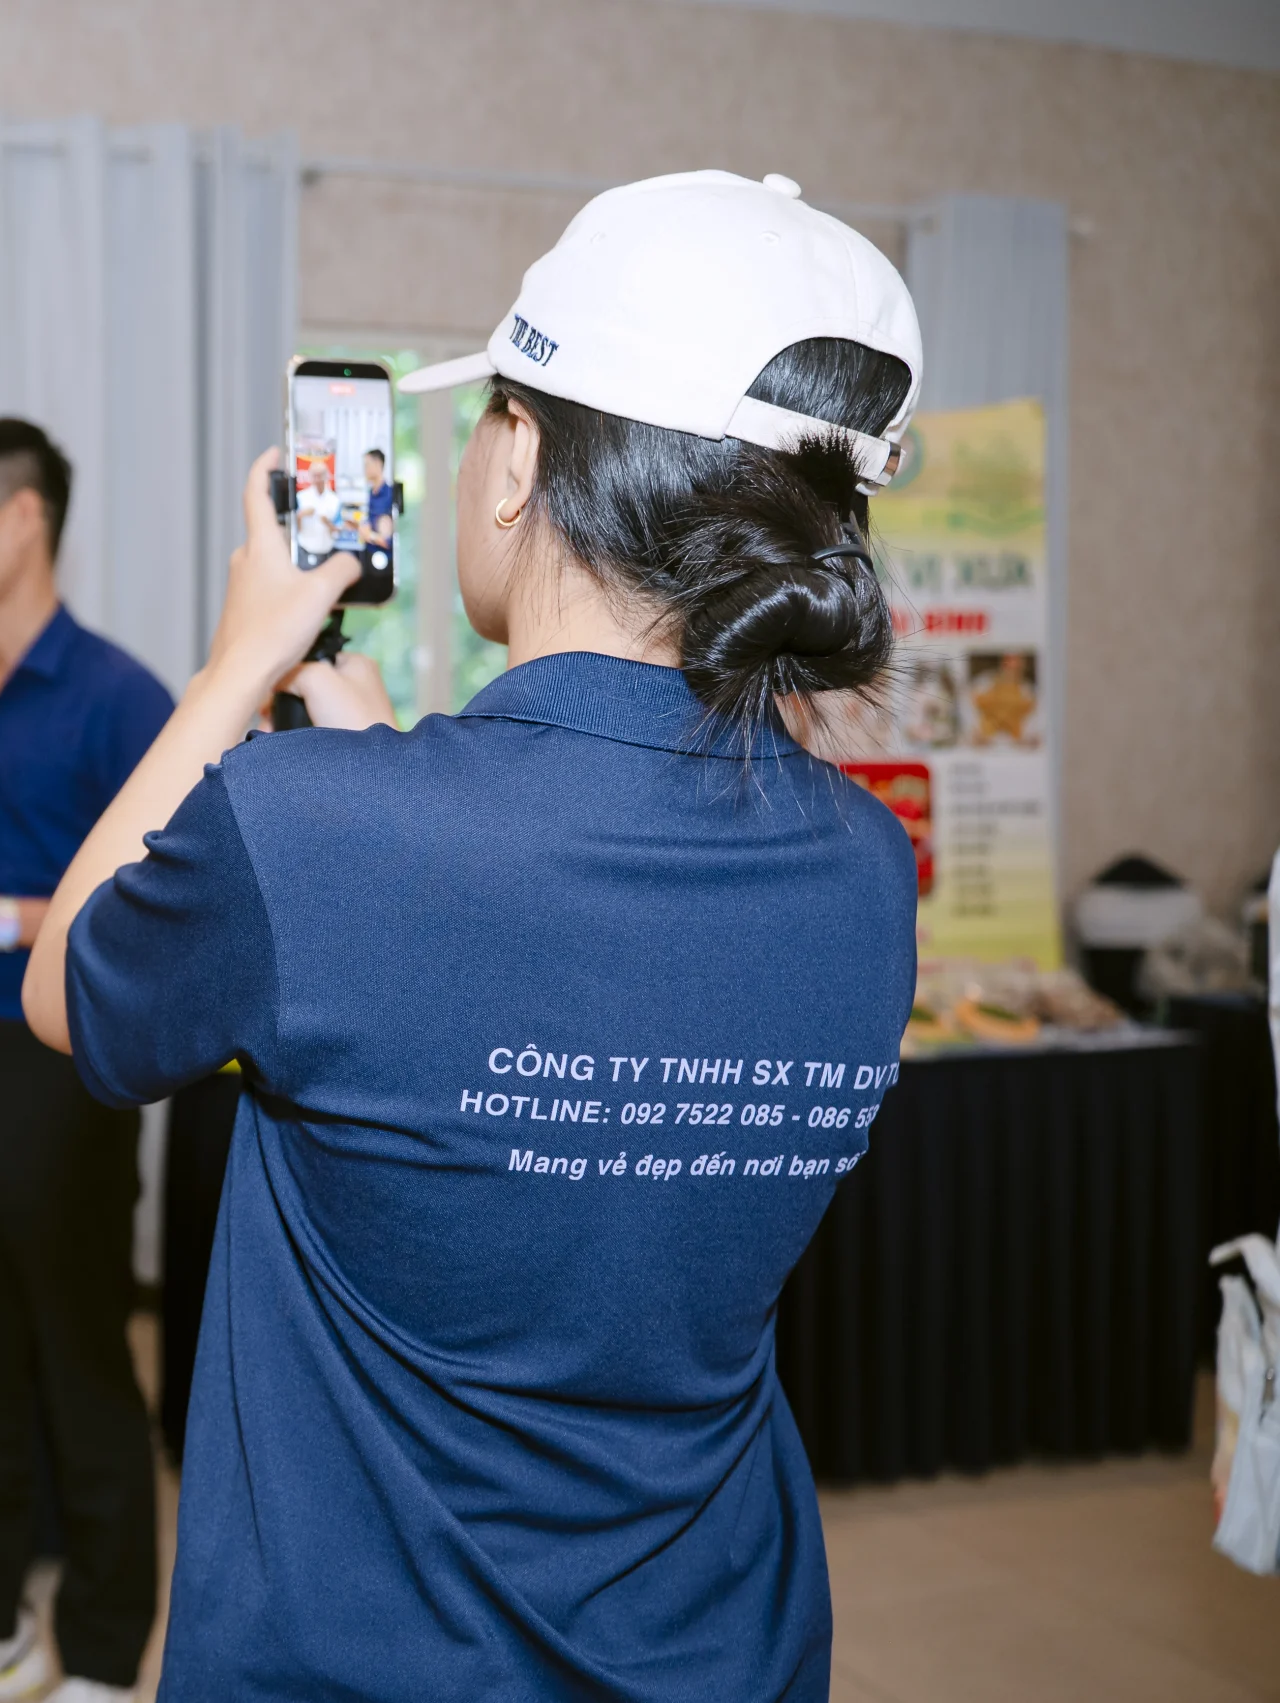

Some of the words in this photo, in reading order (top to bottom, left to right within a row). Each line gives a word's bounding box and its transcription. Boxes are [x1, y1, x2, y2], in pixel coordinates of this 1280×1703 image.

[521, 325, 560, 367] BEST
[488, 1043, 595, 1081] CÔNG
[609, 1056, 650, 1083] TY
[660, 1057, 743, 1085] TNHH
[752, 1059, 794, 1086] SX
[804, 1061, 846, 1089] TM
[853, 1065, 887, 1090] DV
[460, 1089, 611, 1124] HOTLINE:
[620, 1102, 666, 1125] 092
[674, 1103, 734, 1126] 7522
[740, 1103, 786, 1127] 085
[807, 1105, 851, 1129] 086
[508, 1149, 588, 1181] Mang
[598, 1151, 627, 1176] vẻ
[635, 1153, 682, 1181] đẹp
[690, 1151, 736, 1176] đến
[743, 1154, 784, 1176] nơi
[788, 1154, 829, 1180] bạn
